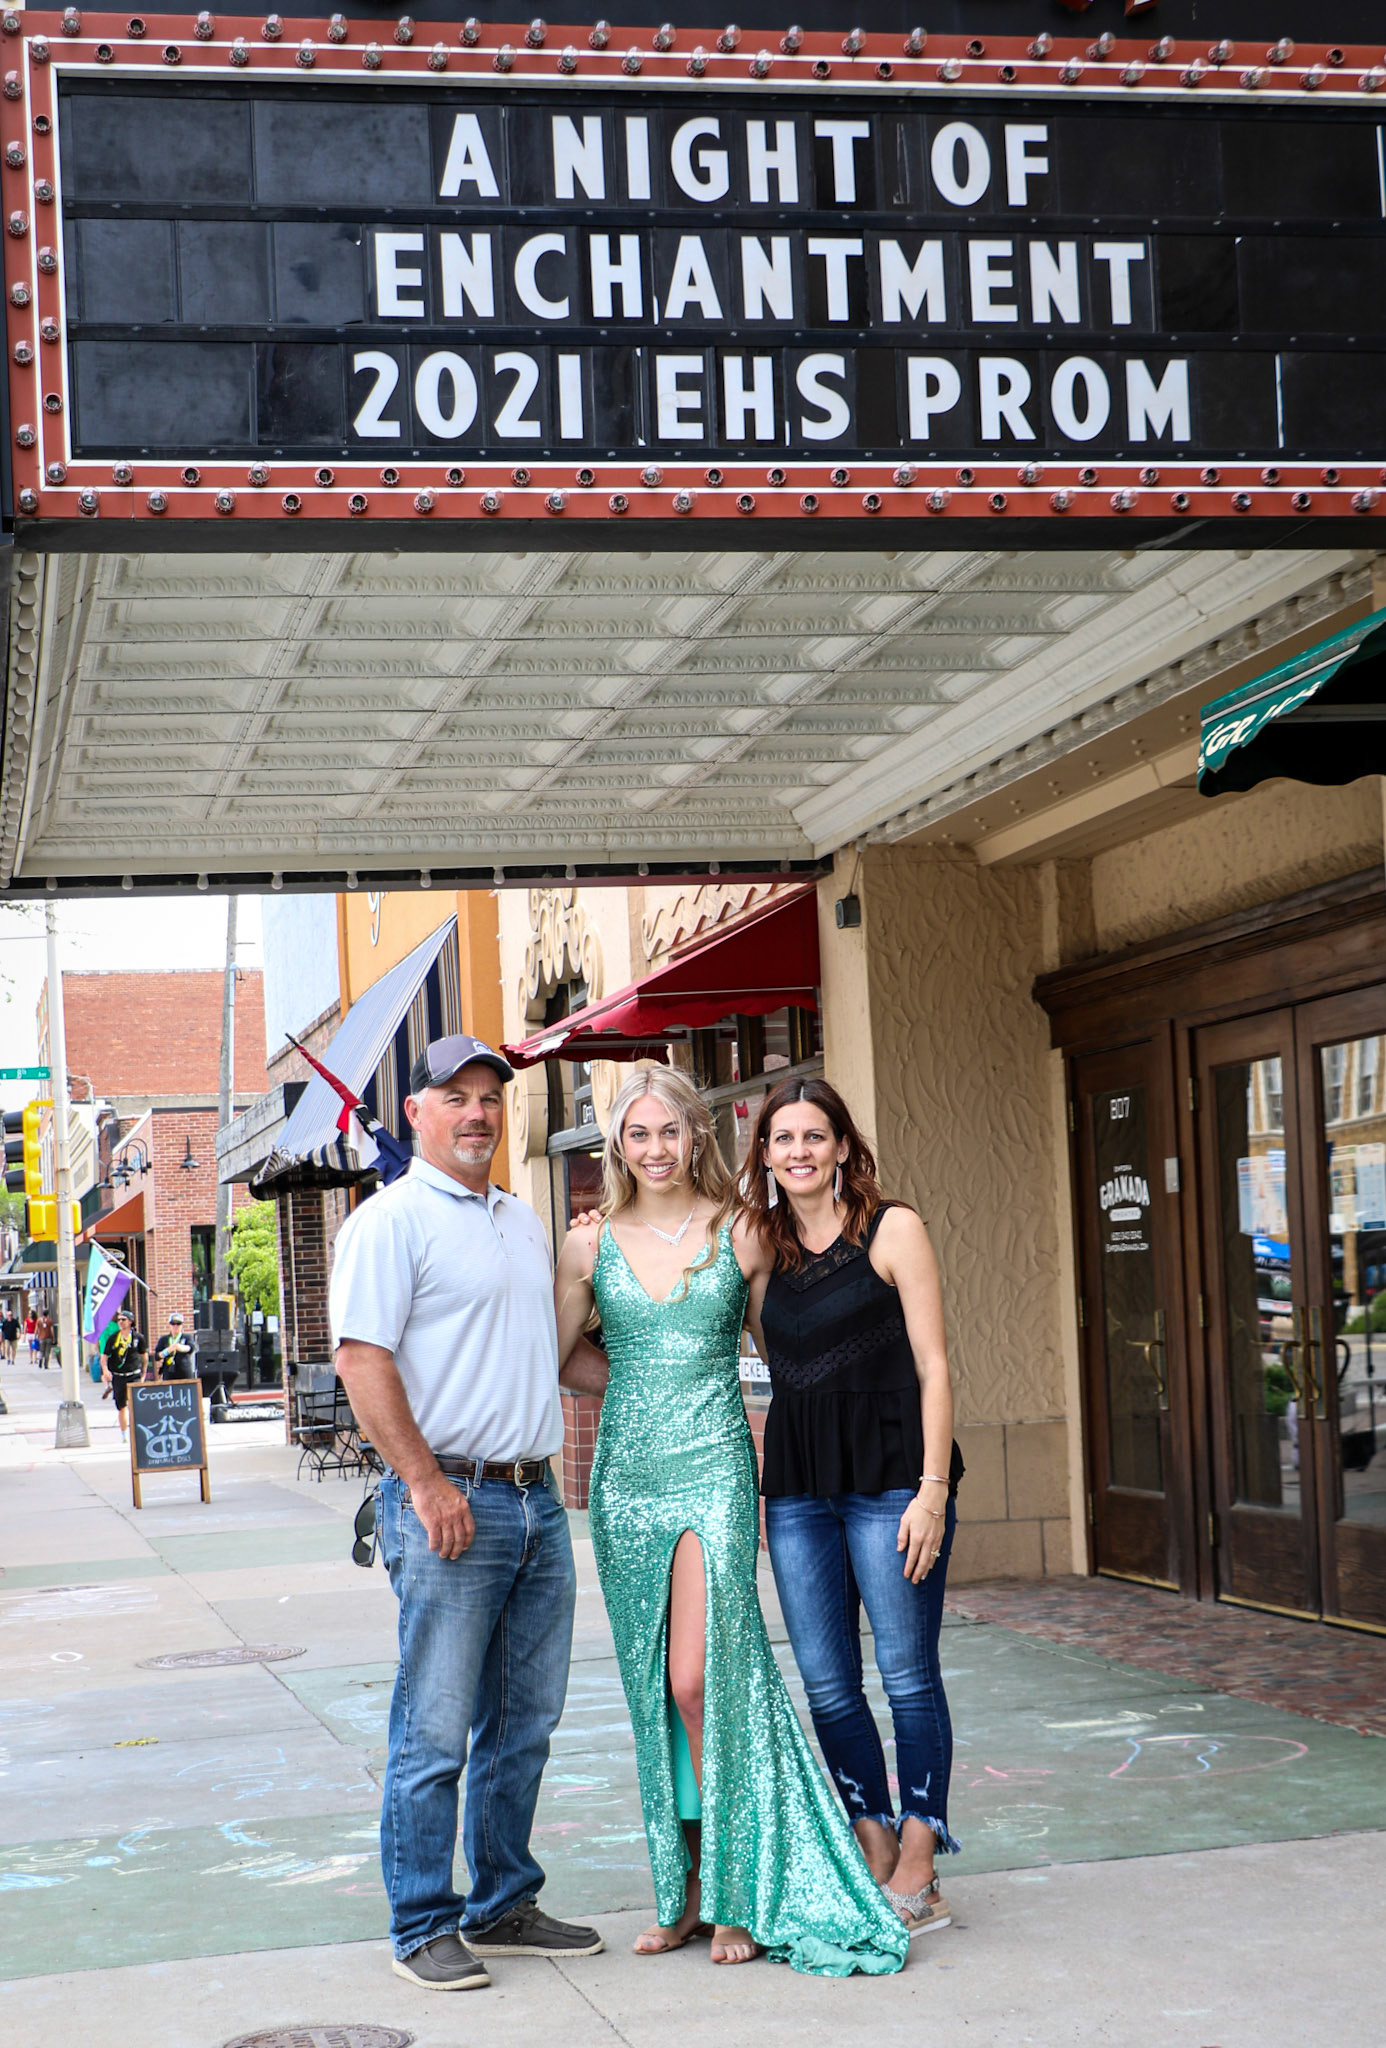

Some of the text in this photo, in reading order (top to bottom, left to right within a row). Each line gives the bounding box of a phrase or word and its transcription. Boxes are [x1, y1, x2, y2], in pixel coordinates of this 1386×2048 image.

[440, 114, 1049, 206] A NIGHT OF
[374, 232, 1145, 325] ENCHANTMENT
[353, 351, 1191, 442] 2021 EHS PROM
[1100, 1175, 1150, 1210] GRANADA
[137, 1385, 174, 1401] Good
